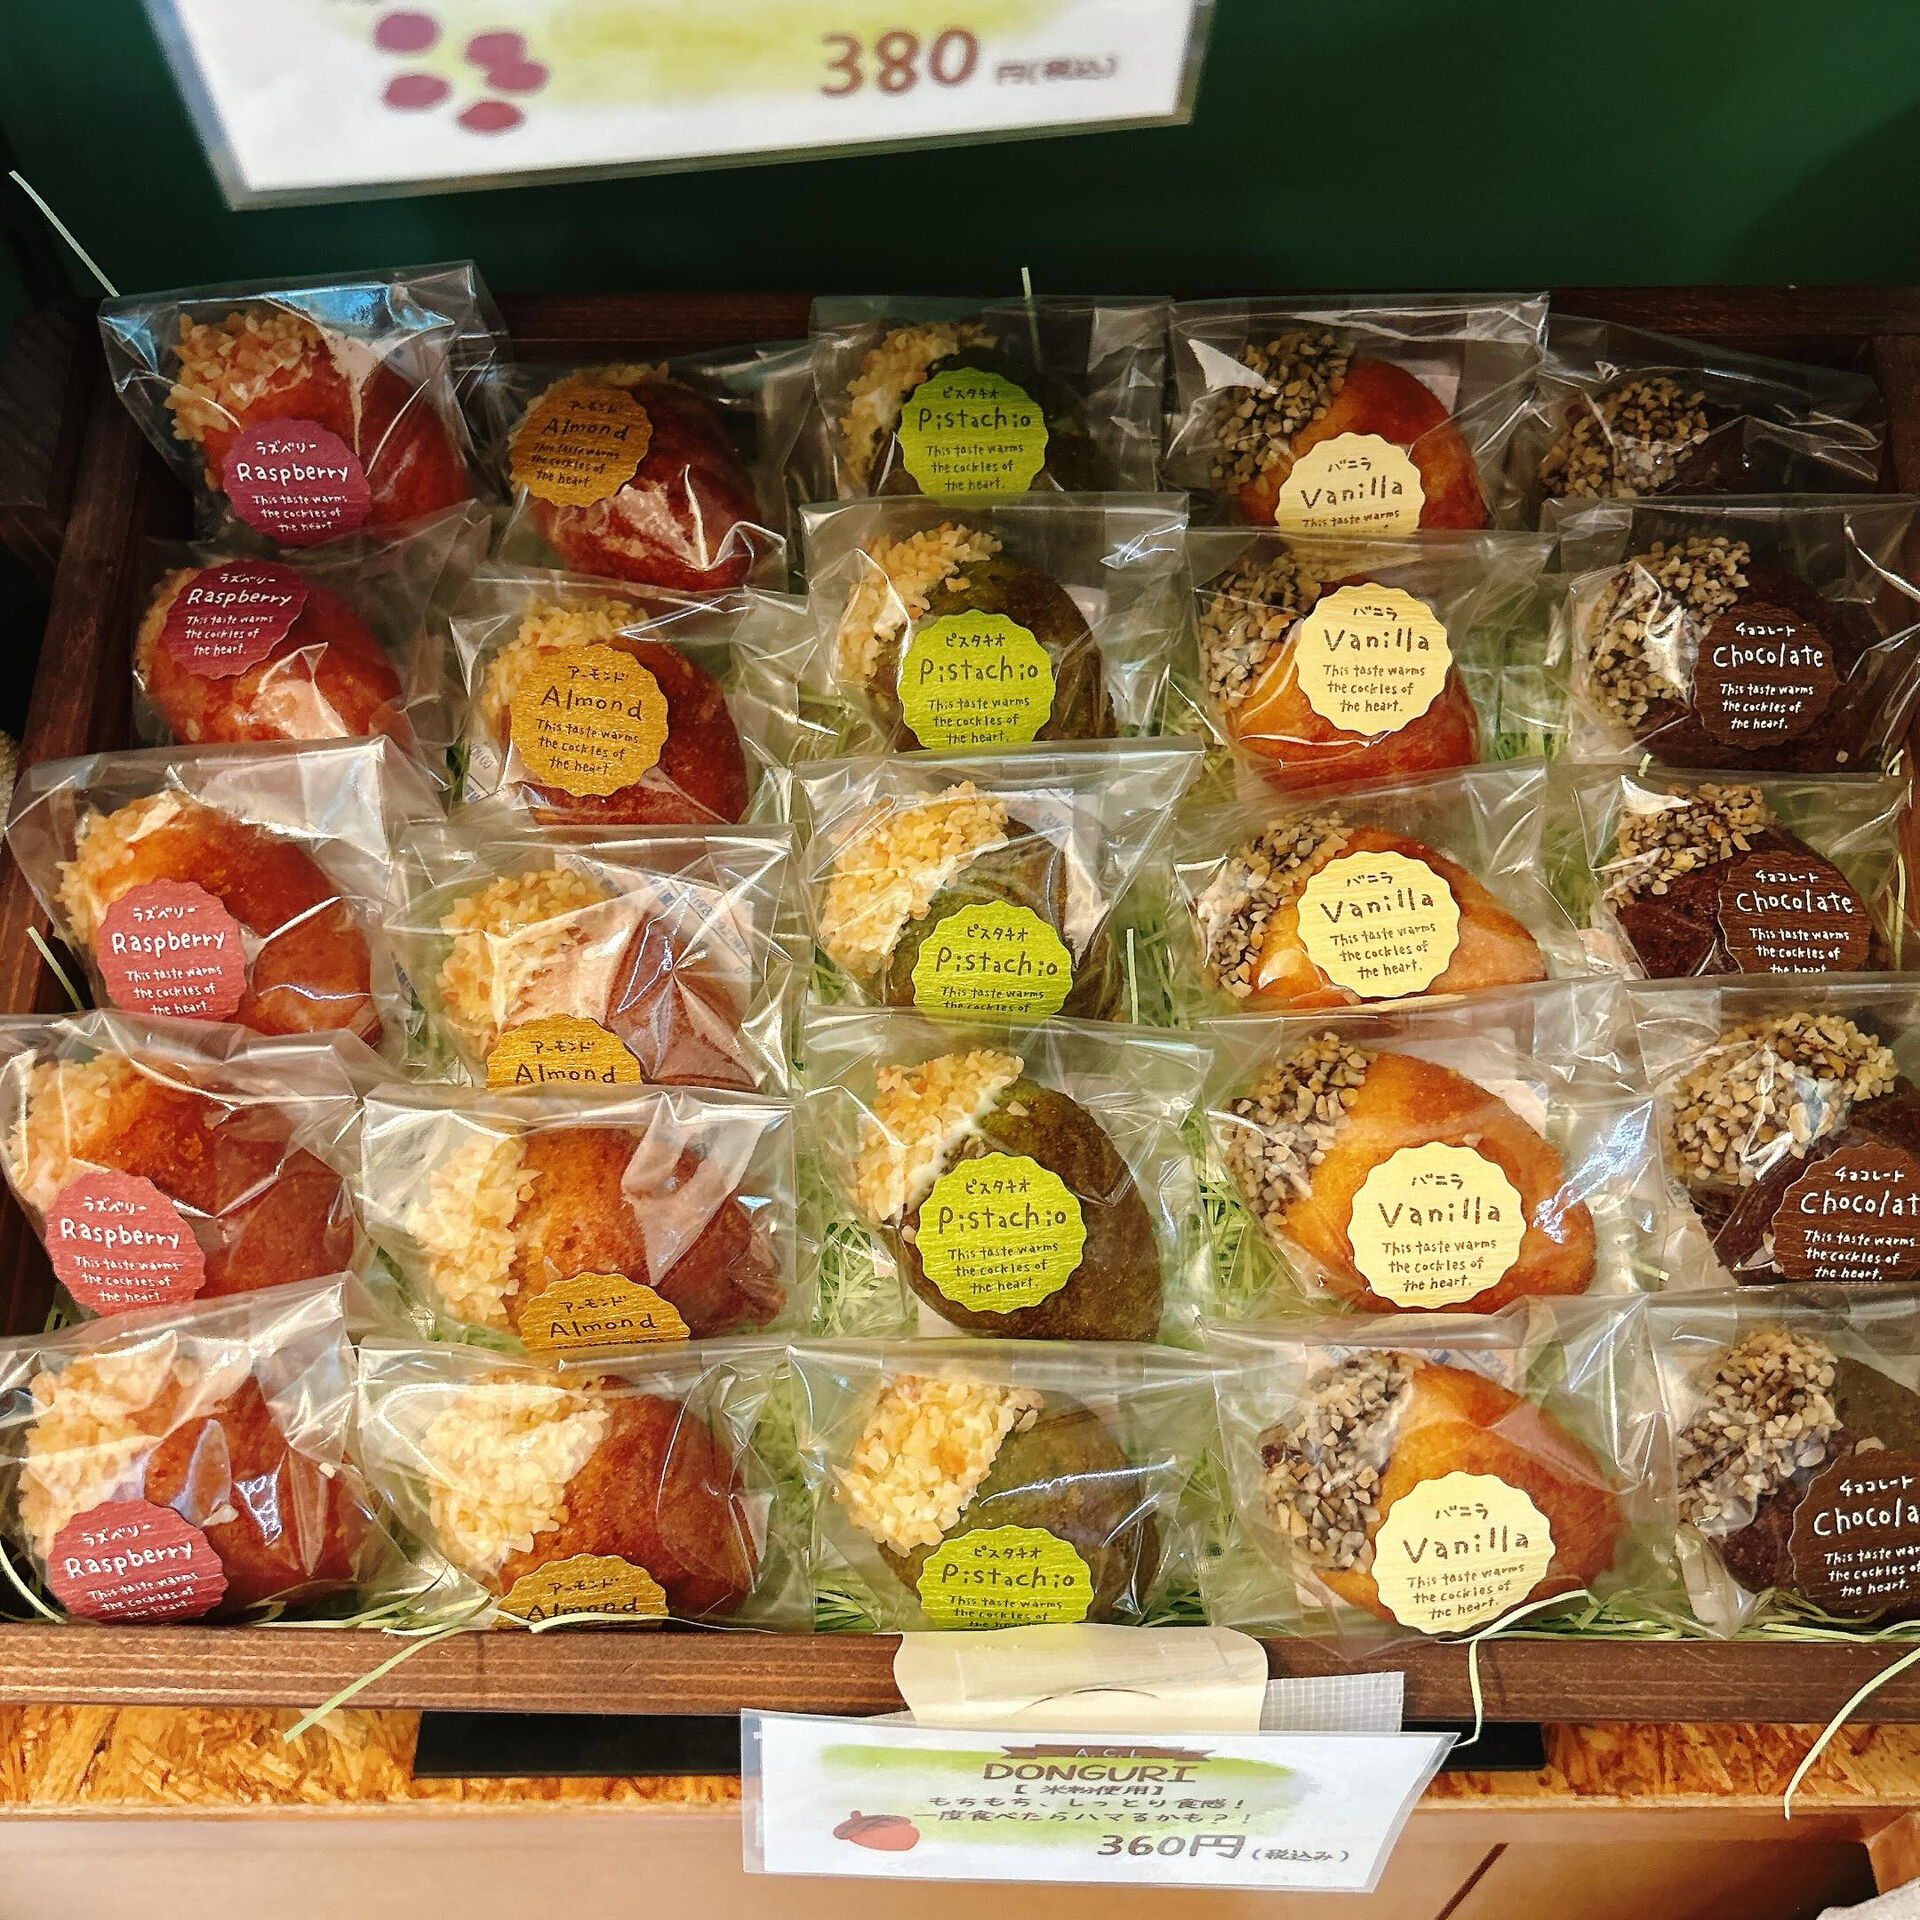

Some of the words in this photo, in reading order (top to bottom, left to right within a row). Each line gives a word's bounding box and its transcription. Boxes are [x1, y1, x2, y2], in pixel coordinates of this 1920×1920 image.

[819, 26, 980, 97] 380
[942, 387, 998, 400] ピスタチオ
[918, 408, 1031, 432] Pistachio
[542, 418, 631, 441] Almond
[256, 441, 318, 454] ラズベリー
[925, 445, 952, 457] This
[957, 444, 986, 454] taste
[989, 443, 1024, 452] warms
[931, 461, 949, 472] the
[951, 460, 998, 472] cockles
[1002, 460, 1014, 471] of
[1327, 457, 1371, 472] バニラ
[237, 463, 348, 487] Raspberry
[945, 479, 964, 491] the
[968, 477, 1005, 490] heart.
[1300, 476, 1403, 508] Vanilla
[220, 573, 276, 583] ラズベリー
[187, 588, 292, 607] Raspberry
[1353, 606, 1398, 621] バニラ
[1735, 622, 1796, 636] チョコレート
[944, 633, 1005, 649] ピスタチオ
[1323, 628, 1429, 652] Vanilla
[1713, 643, 1824, 668] Chocolate
[568, 665, 628, 682] アーモンド
[919, 655, 1039, 684] Pistachio
[1323, 664, 1346, 676] This
[1355, 665, 1384, 676] taste
[1387, 666, 1425, 677] warms
[1327, 681, 1346, 693] the
[1350, 683, 1398, 694] cockles
[1401, 683, 1414, 695] of
[1720, 684, 1745, 694] This
[1747, 684, 1776, 696] taste
[1778, 686, 1814, 695] warms
[540, 685, 644, 721] Almond
[927, 699, 954, 711] This
[957, 698, 988, 709] taste
[991, 697, 1030, 707] warms
[1339, 700, 1361, 711] the
[1365, 700, 1403, 712] heart.
[1721, 700, 1740, 711] the
[1744, 701, 1786, 713] cockles
[1790, 701, 1801, 713] of
[932, 715, 953, 727] the
[957, 716, 1003, 727] cockles
[1006, 714, 1019, 727] of
[1730, 716, 1750, 729] the
[1753, 718, 1788, 730] heart.
[537, 718, 563, 731] This
[566, 721, 597, 737] taste
[601, 729, 639, 744] warms
[945, 733, 966, 744] the
[970, 731, 1009, 743] heart.
[539, 735, 559, 748] the
[562, 740, 608, 758] cockles
[613, 747, 627, 760] of
[549, 757, 569, 769] the
[1346, 872, 1393, 886] バニラ
[1755, 870, 1819, 883] チョコレート
[1320, 888, 1433, 923] Vanilla
[1736, 889, 1853, 913] Chocolate
[132, 905, 196, 922] ラズベリー
[966, 923, 1028, 941] ピスタチオ
[1330, 934, 1357, 946] This
[1361, 928, 1393, 943] taste
[1397, 923, 1436, 937] warms
[111, 931, 224, 958] Raspberry
[1338, 949, 1361, 962] the
[1364, 944, 1412, 960] cockles
[1416, 940, 1428, 954] of
[935, 946, 1057, 976] Pistachio
[1358, 966, 1379, 980] the
[1383, 959, 1423, 974] heart.
[125, 971, 150, 983] This
[153, 968, 182, 980] taste
[186, 965, 222, 976] warms
[133, 987, 152, 998] the
[156, 984, 200, 998] cockles
[203, 982, 216, 994] of
[150, 1003, 170, 1015] the
[173, 1000, 212, 1014] heart.
[529, 1039, 595, 1054] アーモンド
[515, 1064, 616, 1084] Almond
[1411, 1173, 1463, 1189] バニラ
[1835, 1166, 1904, 1182] チョコレート
[965, 1178, 1030, 1194] ピスタチオ
[83, 1195, 147, 1214] ラズベリー
[1800, 1190, 1920, 1216] Chocolat
[938, 1203, 1066, 1234] Pistachio
[1378, 1196, 1500, 1228] Vanilla
[60, 1218, 180, 1249] Raspberry
[1803, 1230, 1832, 1243] This
[1836, 1231, 1870, 1244] taste
[1875, 1235, 1915, 1246] warms
[946, 1248, 975, 1261] This
[980, 1245, 1013, 1258] taste
[1018, 1242, 1058, 1254] warms
[1381, 1241, 1410, 1254] This
[1418, 1240, 1451, 1252] taste
[1455, 1240, 1496, 1251] warms
[73, 1255, 101, 1270] This
[103, 1257, 135, 1271] taste
[140, 1261, 178, 1272] warms
[1388, 1260, 1409, 1272] the
[1413, 1259, 1467, 1272] cockles
[1471, 1257, 1484, 1270] of
[1805, 1248, 1828, 1261] the
[1830, 1251, 1882, 1263] cockles
[1886, 1252, 1900, 1265] of
[954, 1264, 975, 1276] the
[979, 1261, 1029, 1276] cockles
[1034, 1258, 1048, 1270] of
[1815, 1266, 1837, 1278] the
[1841, 1267, 1882, 1280] heart.
[81, 1272, 101, 1284] the
[106, 1274, 152, 1287] cockles
[156, 1274, 172, 1287] of
[970, 1282, 992, 1294] the
[996, 1277, 1038, 1291] heart.
[1403, 1278, 1425, 1291] the
[1430, 1275, 1470, 1289] heart.
[98, 1291, 121, 1302] the
[124, 1290, 167, 1302] heart.
[559, 1296, 626, 1312] アーモンド
[550, 1314, 657, 1338] Almond
[1839, 1475, 1912, 1497] チョコレート
[1435, 1503, 1488, 1520] バニラ
[1813, 1498, 1920, 1536] Chocola
[81, 1524, 151, 1545] ラズベリー
[974, 1547, 1041, 1559] ピスタチオ
[1402, 1526, 1528, 1563] Vanilla
[65, 1542, 193, 1579] Raspberry
[941, 1563, 1074, 1588] Pistachio
[1408, 1575, 1436, 1589] This
[1441, 1571, 1476, 1584] taste
[1481, 1565, 1524, 1577] warms
[548, 1577, 619, 1593] アーモンド
[1412, 1592, 1437, 1605] the
[1441, 1586, 1491, 1602] cockles
[1496, 1580, 1511, 1594] of
[527, 1598, 639, 1620] Almond
[1428, 1608, 1451, 1620] the
[1457, 1598, 1498, 1614] heart.
[983, 1763, 1198, 1783] DONGURI
[1096, 1834, 1247, 1859] 360円
